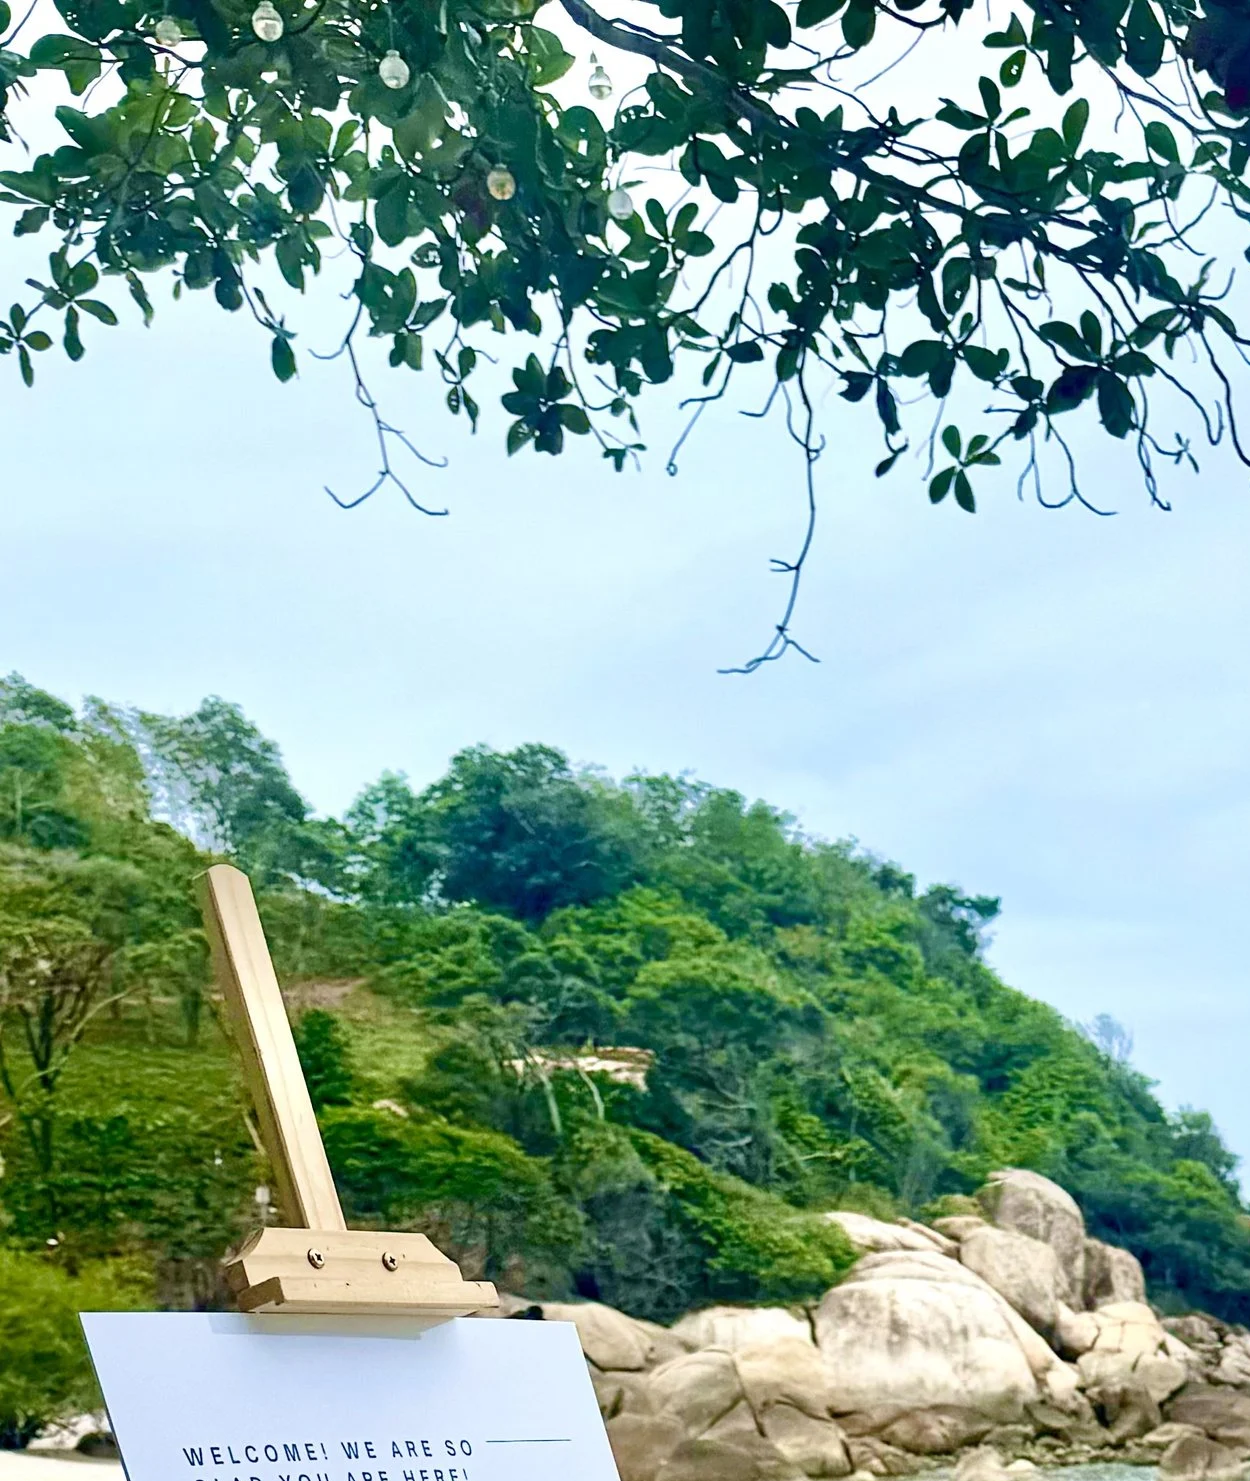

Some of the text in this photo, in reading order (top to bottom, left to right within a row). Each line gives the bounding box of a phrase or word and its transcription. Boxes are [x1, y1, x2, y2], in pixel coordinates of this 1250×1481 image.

[182, 1439, 473, 1467] WELCOME! WE ARE SO
